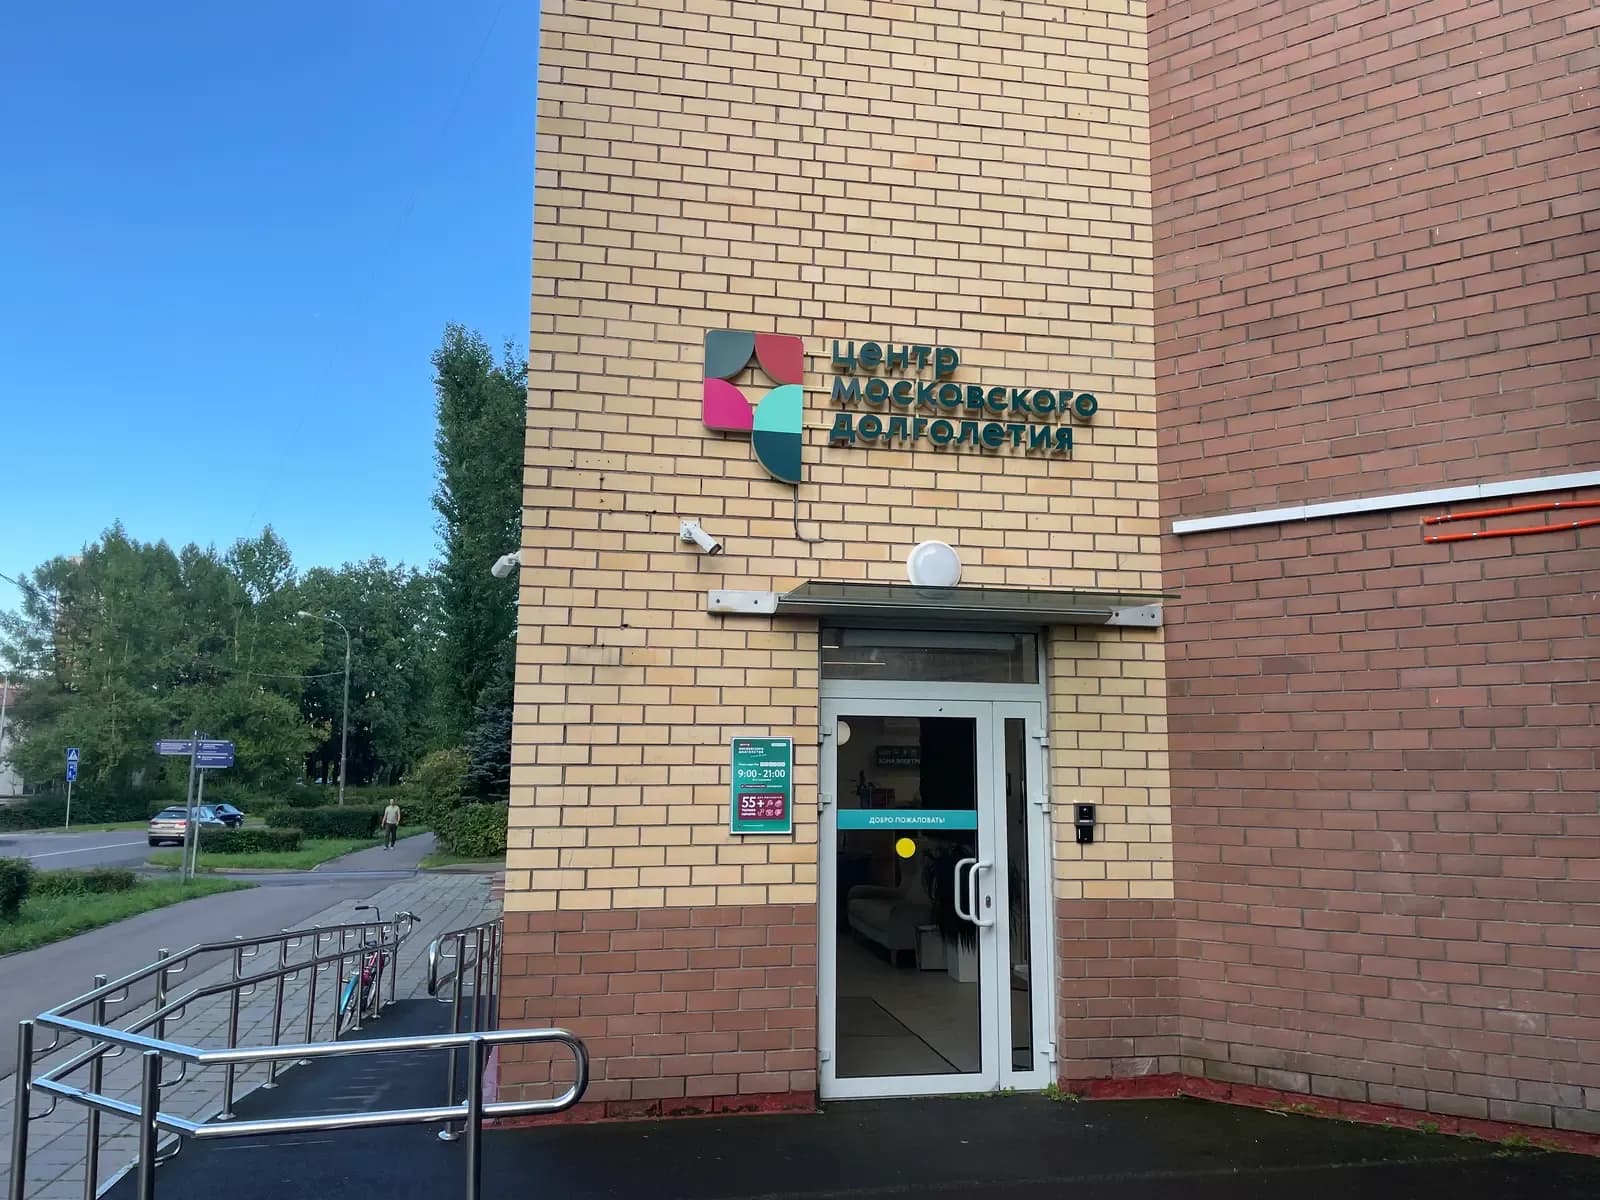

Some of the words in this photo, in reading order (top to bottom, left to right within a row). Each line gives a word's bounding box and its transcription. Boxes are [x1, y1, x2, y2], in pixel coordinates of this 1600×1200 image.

[737, 769, 757, 778] 9:00
[762, 769, 786, 778] 21:00
[741, 796, 765, 808] 55+
[869, 816, 894, 825] ДОБРО
